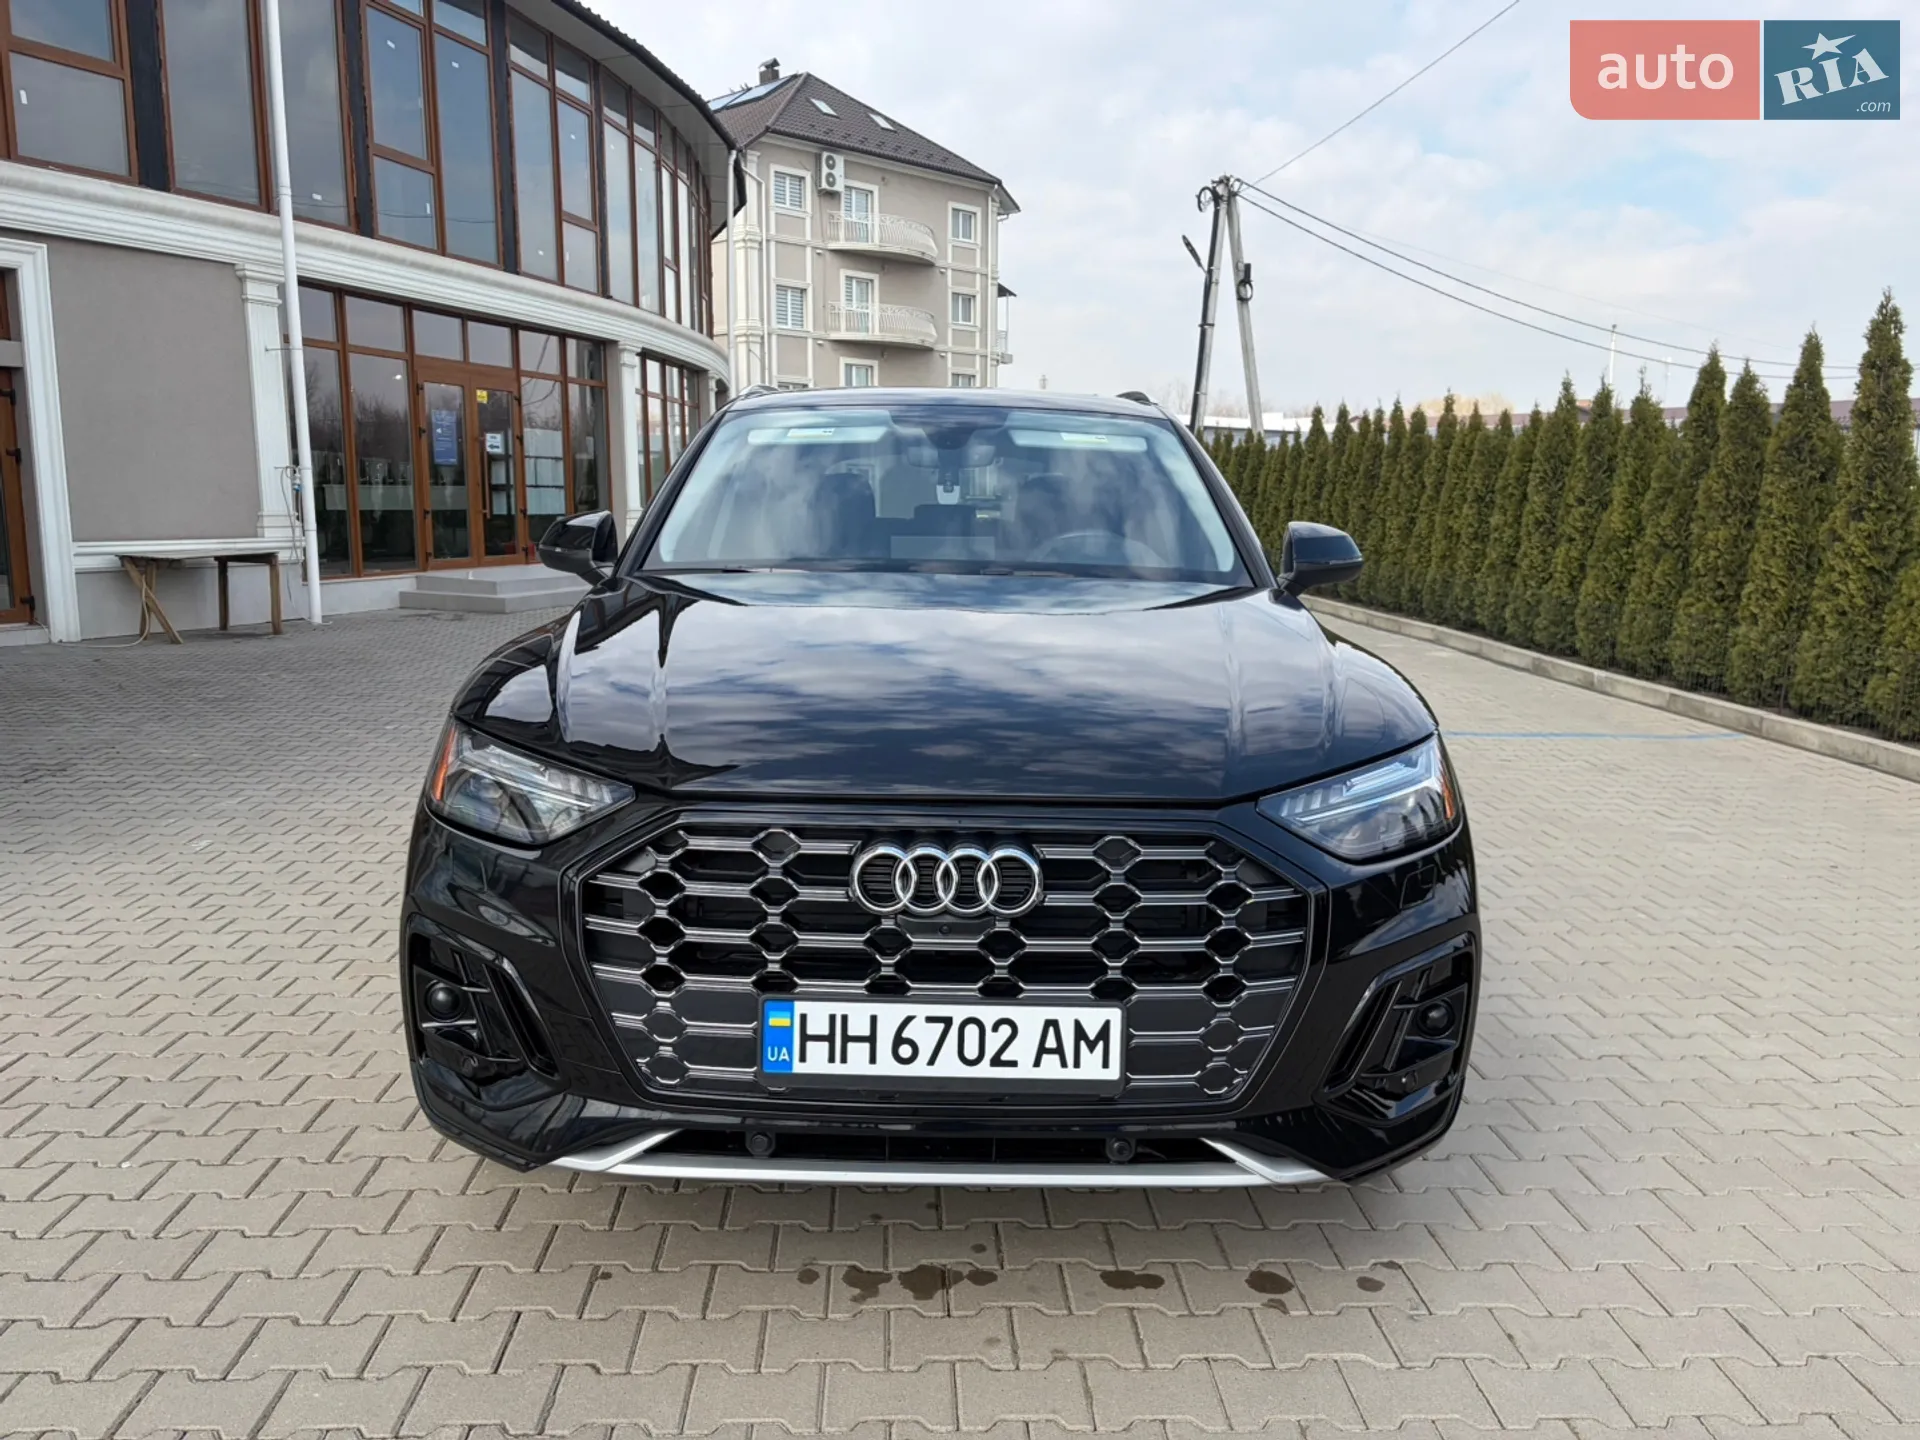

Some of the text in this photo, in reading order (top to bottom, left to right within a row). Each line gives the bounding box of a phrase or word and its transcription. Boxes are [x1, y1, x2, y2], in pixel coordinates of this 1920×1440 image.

[767, 1046, 790, 1062] UA
[798, 1013, 1111, 1069] HH 6702 AM
